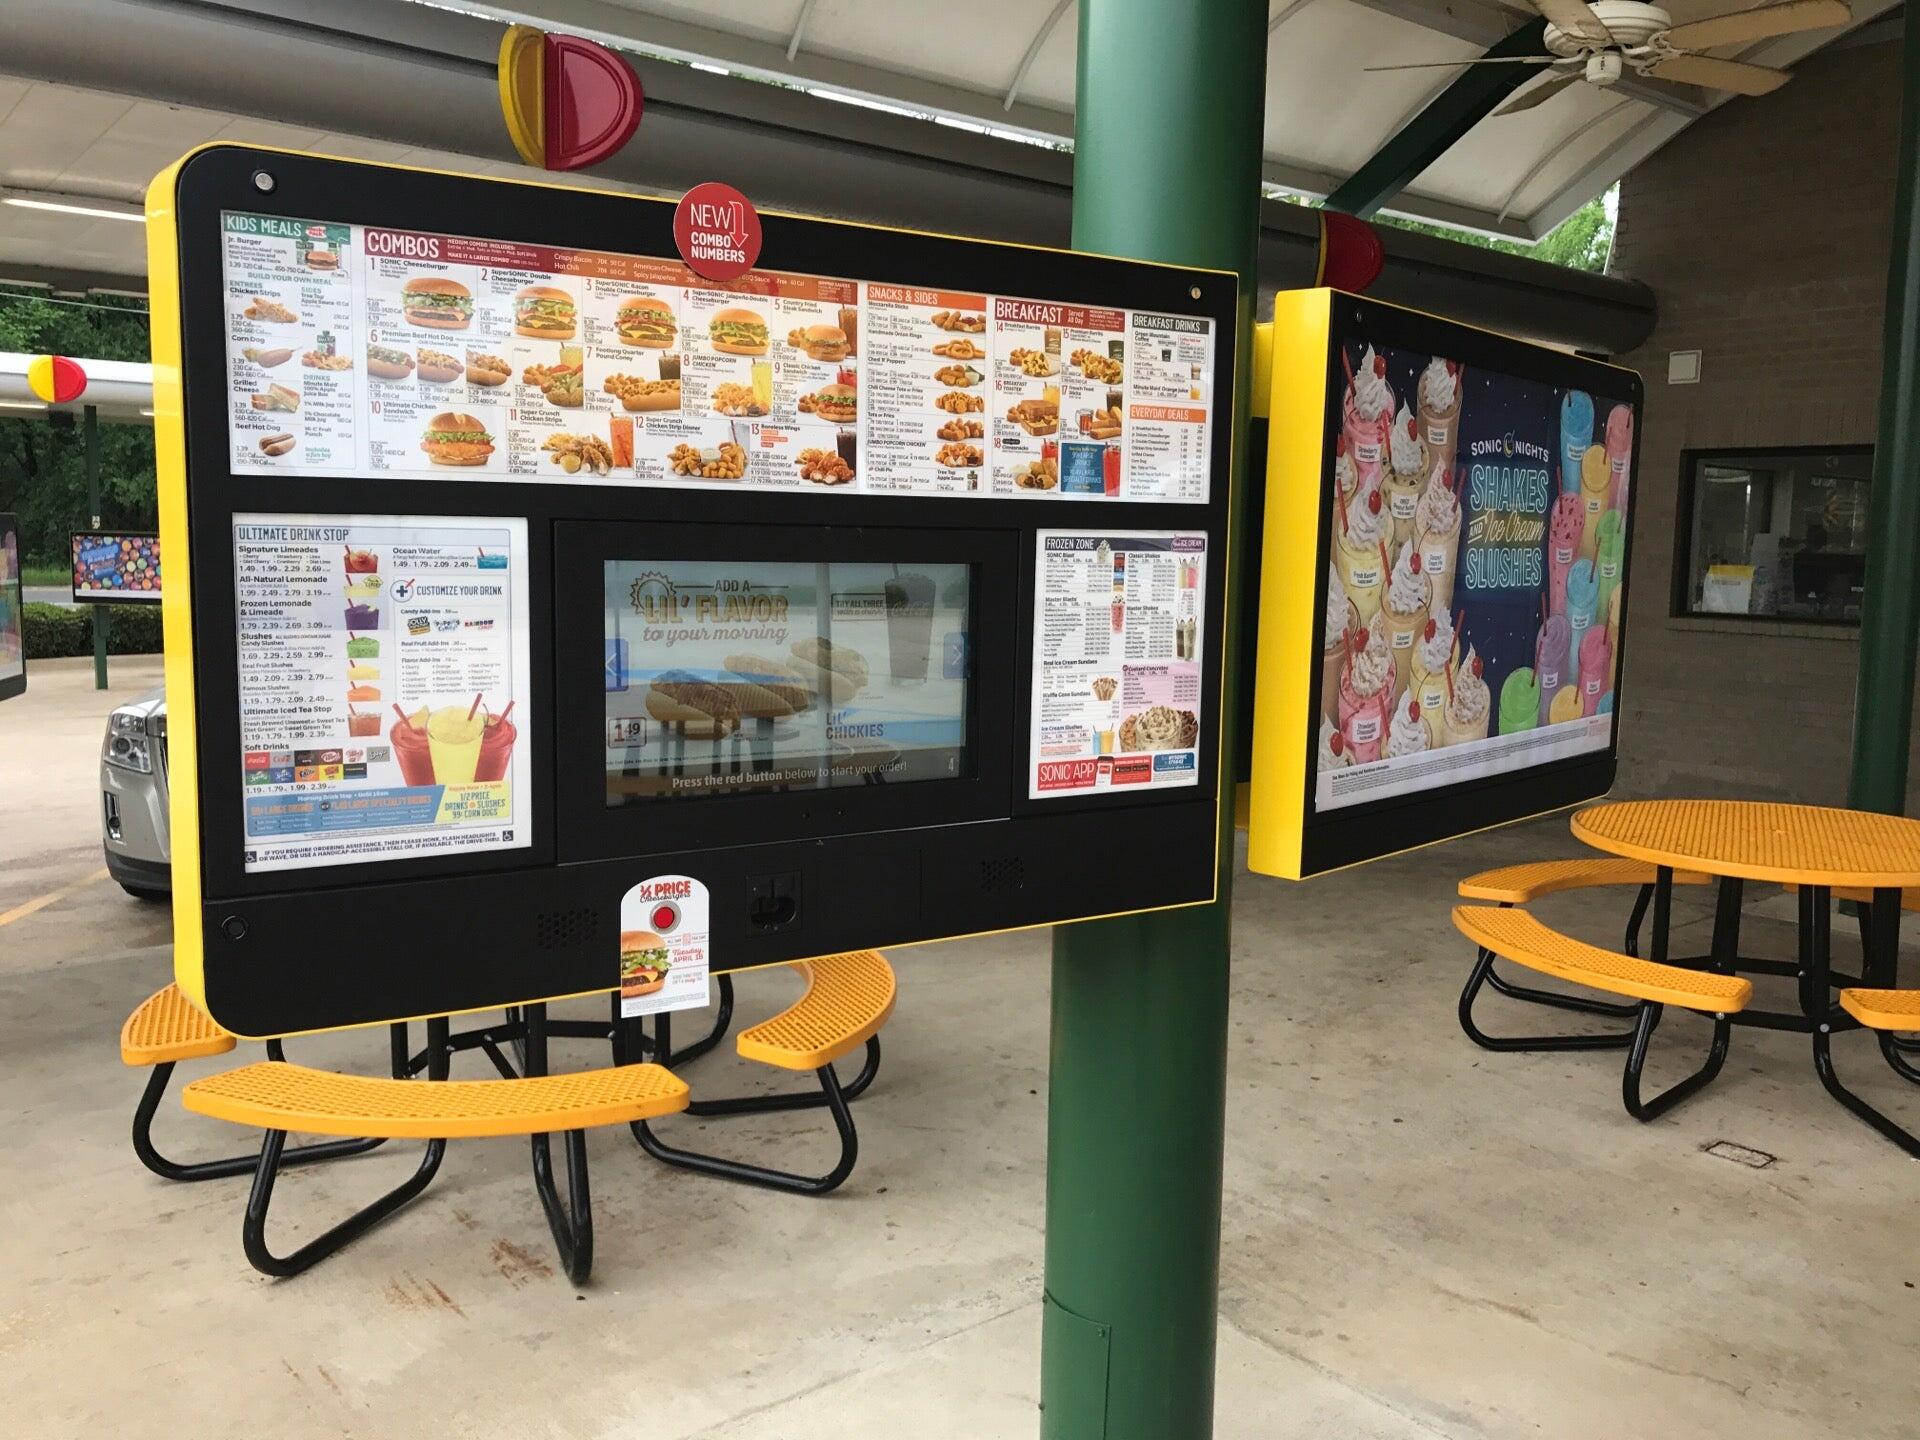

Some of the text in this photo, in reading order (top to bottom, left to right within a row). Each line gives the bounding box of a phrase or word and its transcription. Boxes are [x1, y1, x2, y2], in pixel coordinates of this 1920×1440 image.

[690, 203, 731, 230] NEW
[227, 216, 302, 236] KIDS MEALS
[368, 232, 439, 258] COMBOS
[690, 232, 730, 248] COMBO
[691, 246, 745, 263] NUMBERS
[634, 262, 660, 271] American
[492, 276, 534, 284] Cheeseburger
[870, 286, 938, 304] SNACKS & SIDES
[996, 301, 1063, 324] BREAKFAST
[1134, 315, 1174, 329] BREAKFAST
[1175, 320, 1200, 331] DRINKS
[250, 336, 266, 344] Dog
[370, 330, 378, 342] 6
[382, 330, 412, 338] Premium
[683, 355, 690, 366] 8
[371, 402, 380, 414] 10
[510, 410, 516, 420] 11
[1131, 406, 1188, 420] EVERYDAY DEALS
[636, 416, 644, 428] 12
[1471, 439, 1502, 456] SONIC
[1515, 440, 1549, 462] NIGHTS
[1470, 464, 1549, 514] SHAKES
[1469, 510, 1546, 543] AND Ice Cream
[239, 528, 348, 540] ULTIMATE DRINK STOP
[239, 546, 278, 554] Signature
[1046, 538, 1094, 550] FROZEN ZONE
[1466, 548, 1542, 589] SLUSHES
[416, 586, 502, 595] CUSTOMIZE YOUR DRINK
[715, 580, 750, 592] ADD A
[644, 594, 788, 624] LIL' FLAVOR
[863, 600, 883, 608] THREE
[644, 625, 788, 648] to your morning
[826, 712, 846, 726] LIL'
[826, 724, 884, 740] CHICKIES
[948, 758, 954, 772] 4
[672, 777, 702, 788] Press
[705, 775, 722, 786] the
[726, 772, 743, 784] red
[746, 771, 782, 782] button
[786, 768, 816, 780] below
[831, 766, 854, 776] start
[855, 764, 876, 776] your
[879, 761, 906, 772] order!
[1040, 763, 1094, 782] SONIC APP
[471, 792, 490, 800] PRICE
[445, 800, 505, 810] DRINKS SLUSHES
[655, 880, 691, 896] PRICE
[640, 891, 690, 904] Cheeseburgers
[672, 948, 702, 957] Tuesday
[674, 956, 692, 964] APRIL
